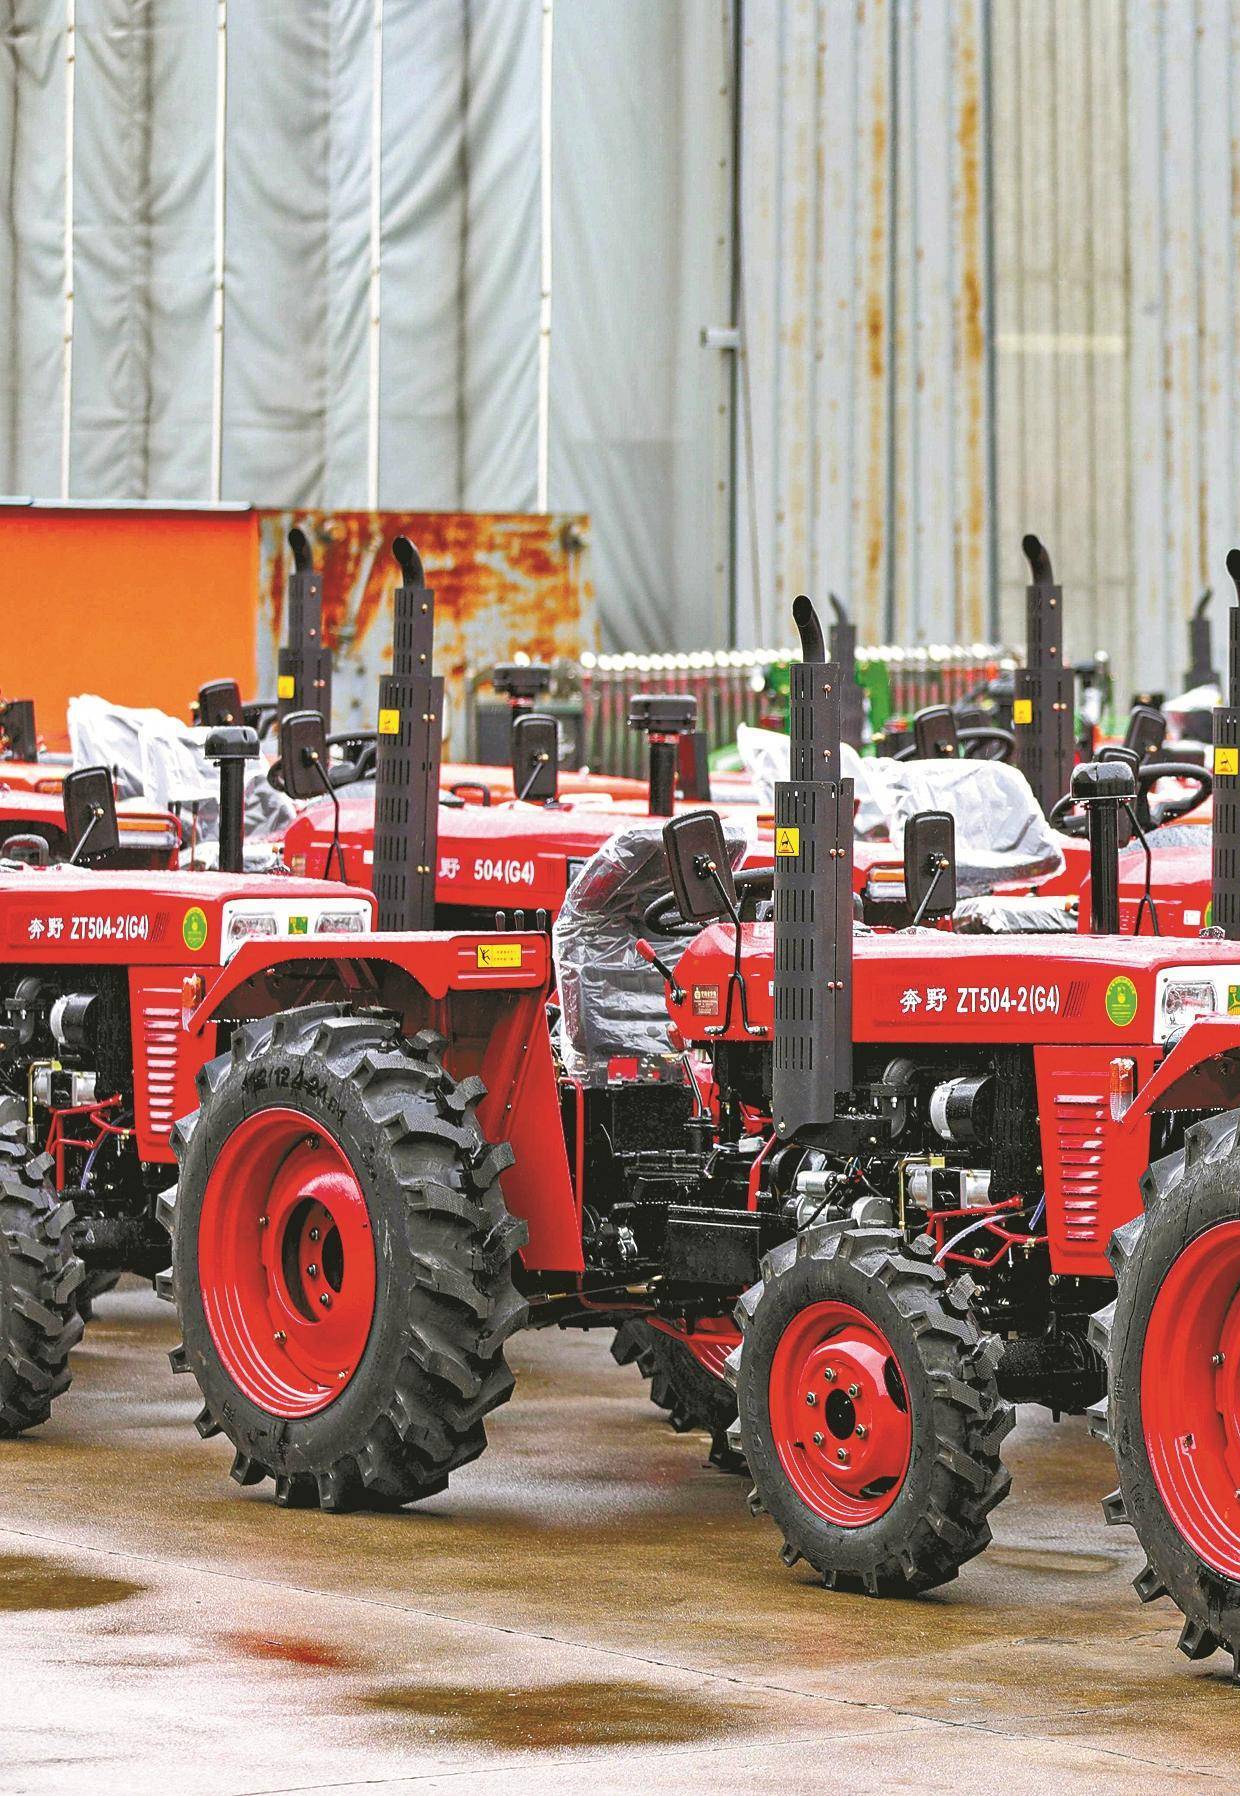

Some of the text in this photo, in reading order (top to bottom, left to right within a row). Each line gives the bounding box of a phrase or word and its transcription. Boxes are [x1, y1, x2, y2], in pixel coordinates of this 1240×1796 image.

[473, 859, 535, 886] 504(G4)
[27, 914, 149, 941] 奔野 ZT504-2(G4)
[899, 984, 1060, 1015] 奔野 ZT504-2(G4)
